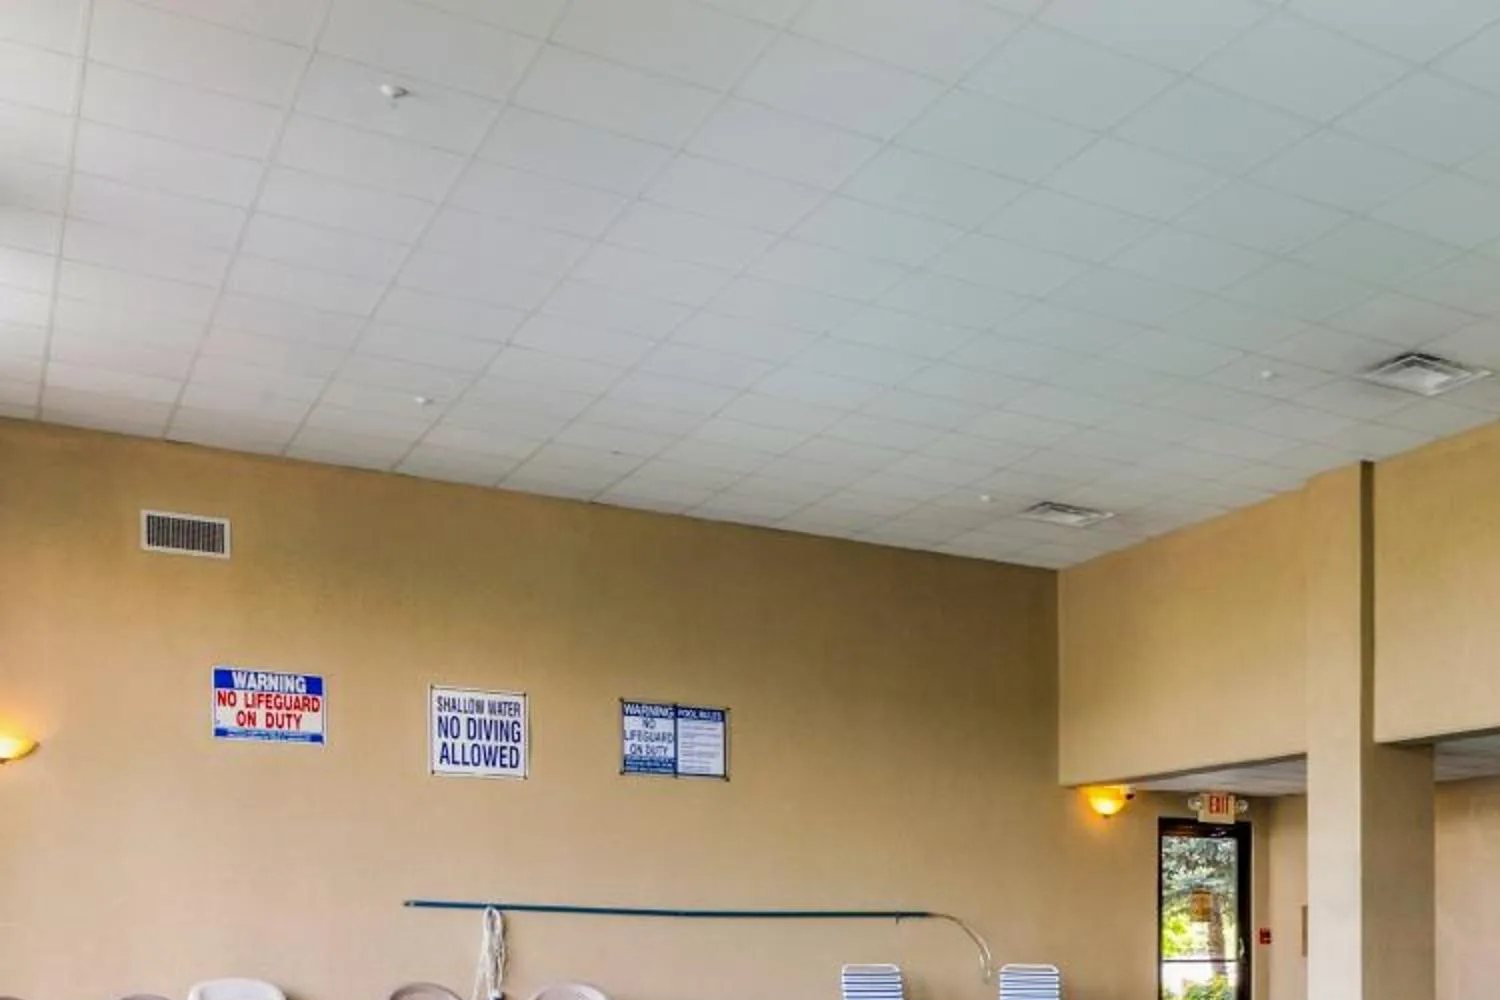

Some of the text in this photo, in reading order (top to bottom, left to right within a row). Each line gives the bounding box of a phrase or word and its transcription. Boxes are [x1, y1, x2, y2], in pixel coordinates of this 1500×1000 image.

[232, 671, 306, 694] WARNING
[217, 691, 320, 712] NO LIFEGUARD
[437, 696, 521, 717] SHALLOW WATER
[624, 703, 674, 719] WARNING
[236, 711, 302, 729] ON DUTY
[438, 716, 521, 743] NO DIVING
[642, 719, 656, 729] NO
[624, 730, 673, 744] LIFEGUARD
[440, 742, 519, 769] ALLOWED
[630, 744, 668, 756] ON DUTY
[1209, 795, 1229, 815] EXIT
